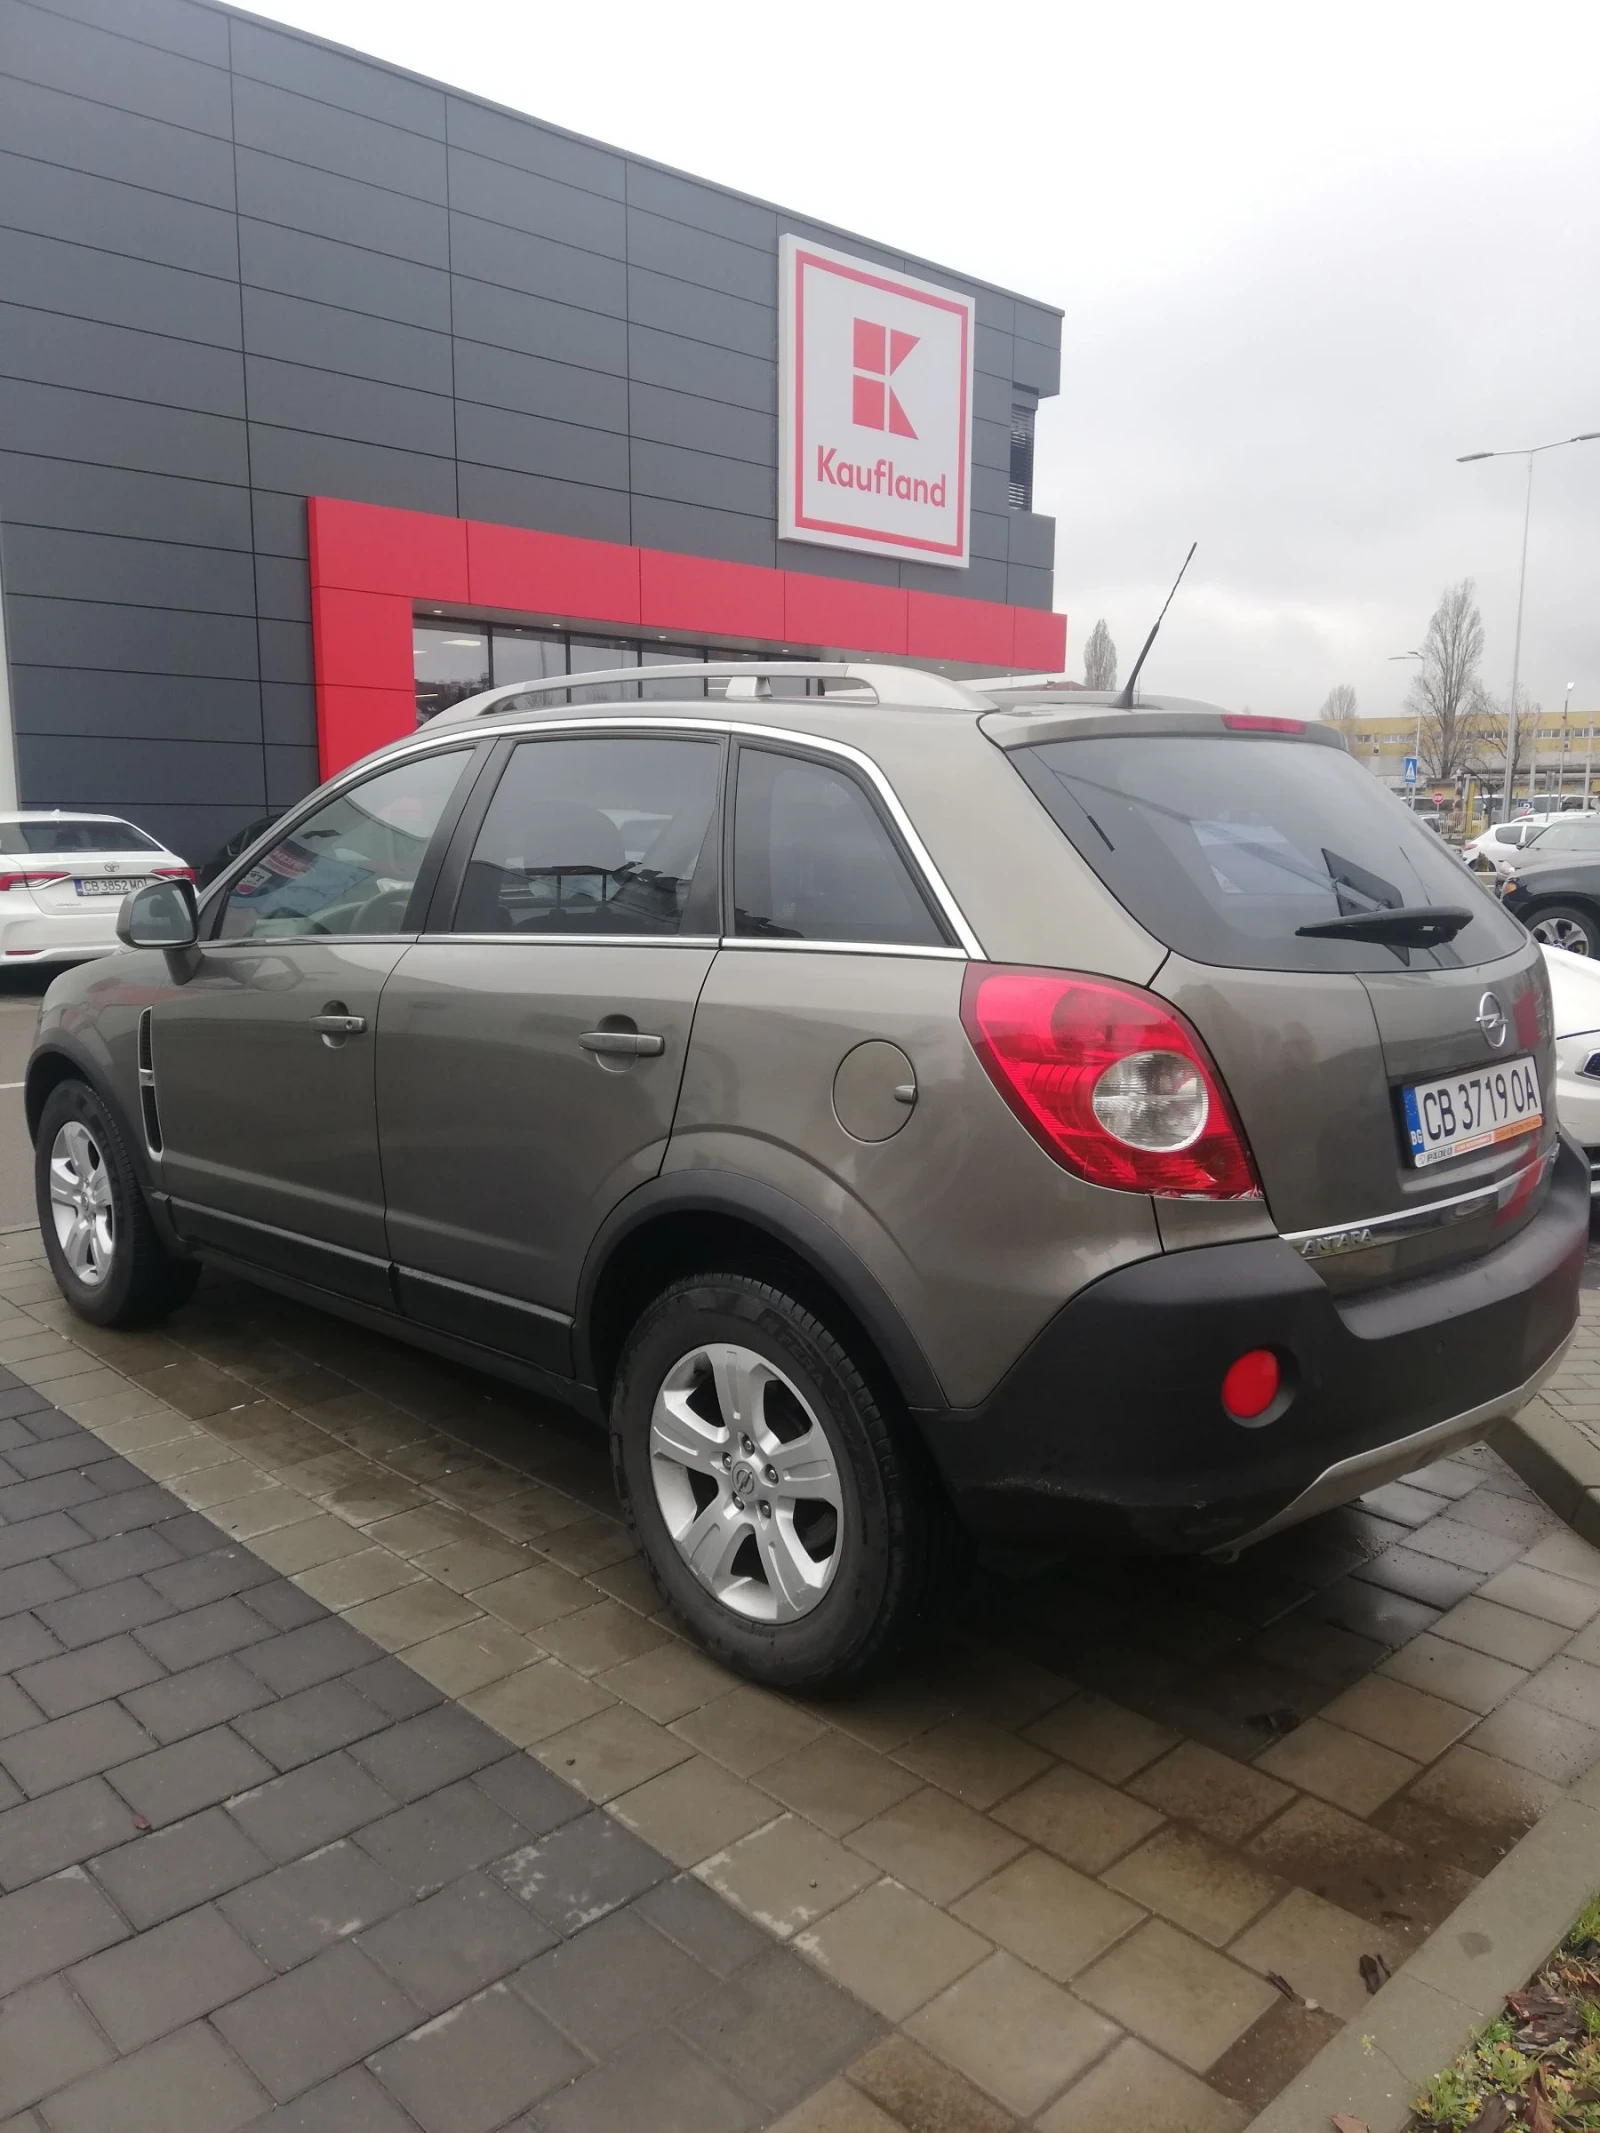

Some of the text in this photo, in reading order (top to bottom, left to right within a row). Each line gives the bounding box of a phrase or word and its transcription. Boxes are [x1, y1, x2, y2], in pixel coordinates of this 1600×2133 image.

[816, 444, 947, 508] Kaufland
[83, 881, 100, 892] CB
[101, 880, 129, 891] 3852
[1423, 1088, 1456, 1141] CB
[1458, 1073, 1509, 1130] 3719
[1511, 1065, 1538, 1113] OA
[1410, 1129, 1423, 1146] BG
[1301, 1228, 1373, 1254] ANTARA
